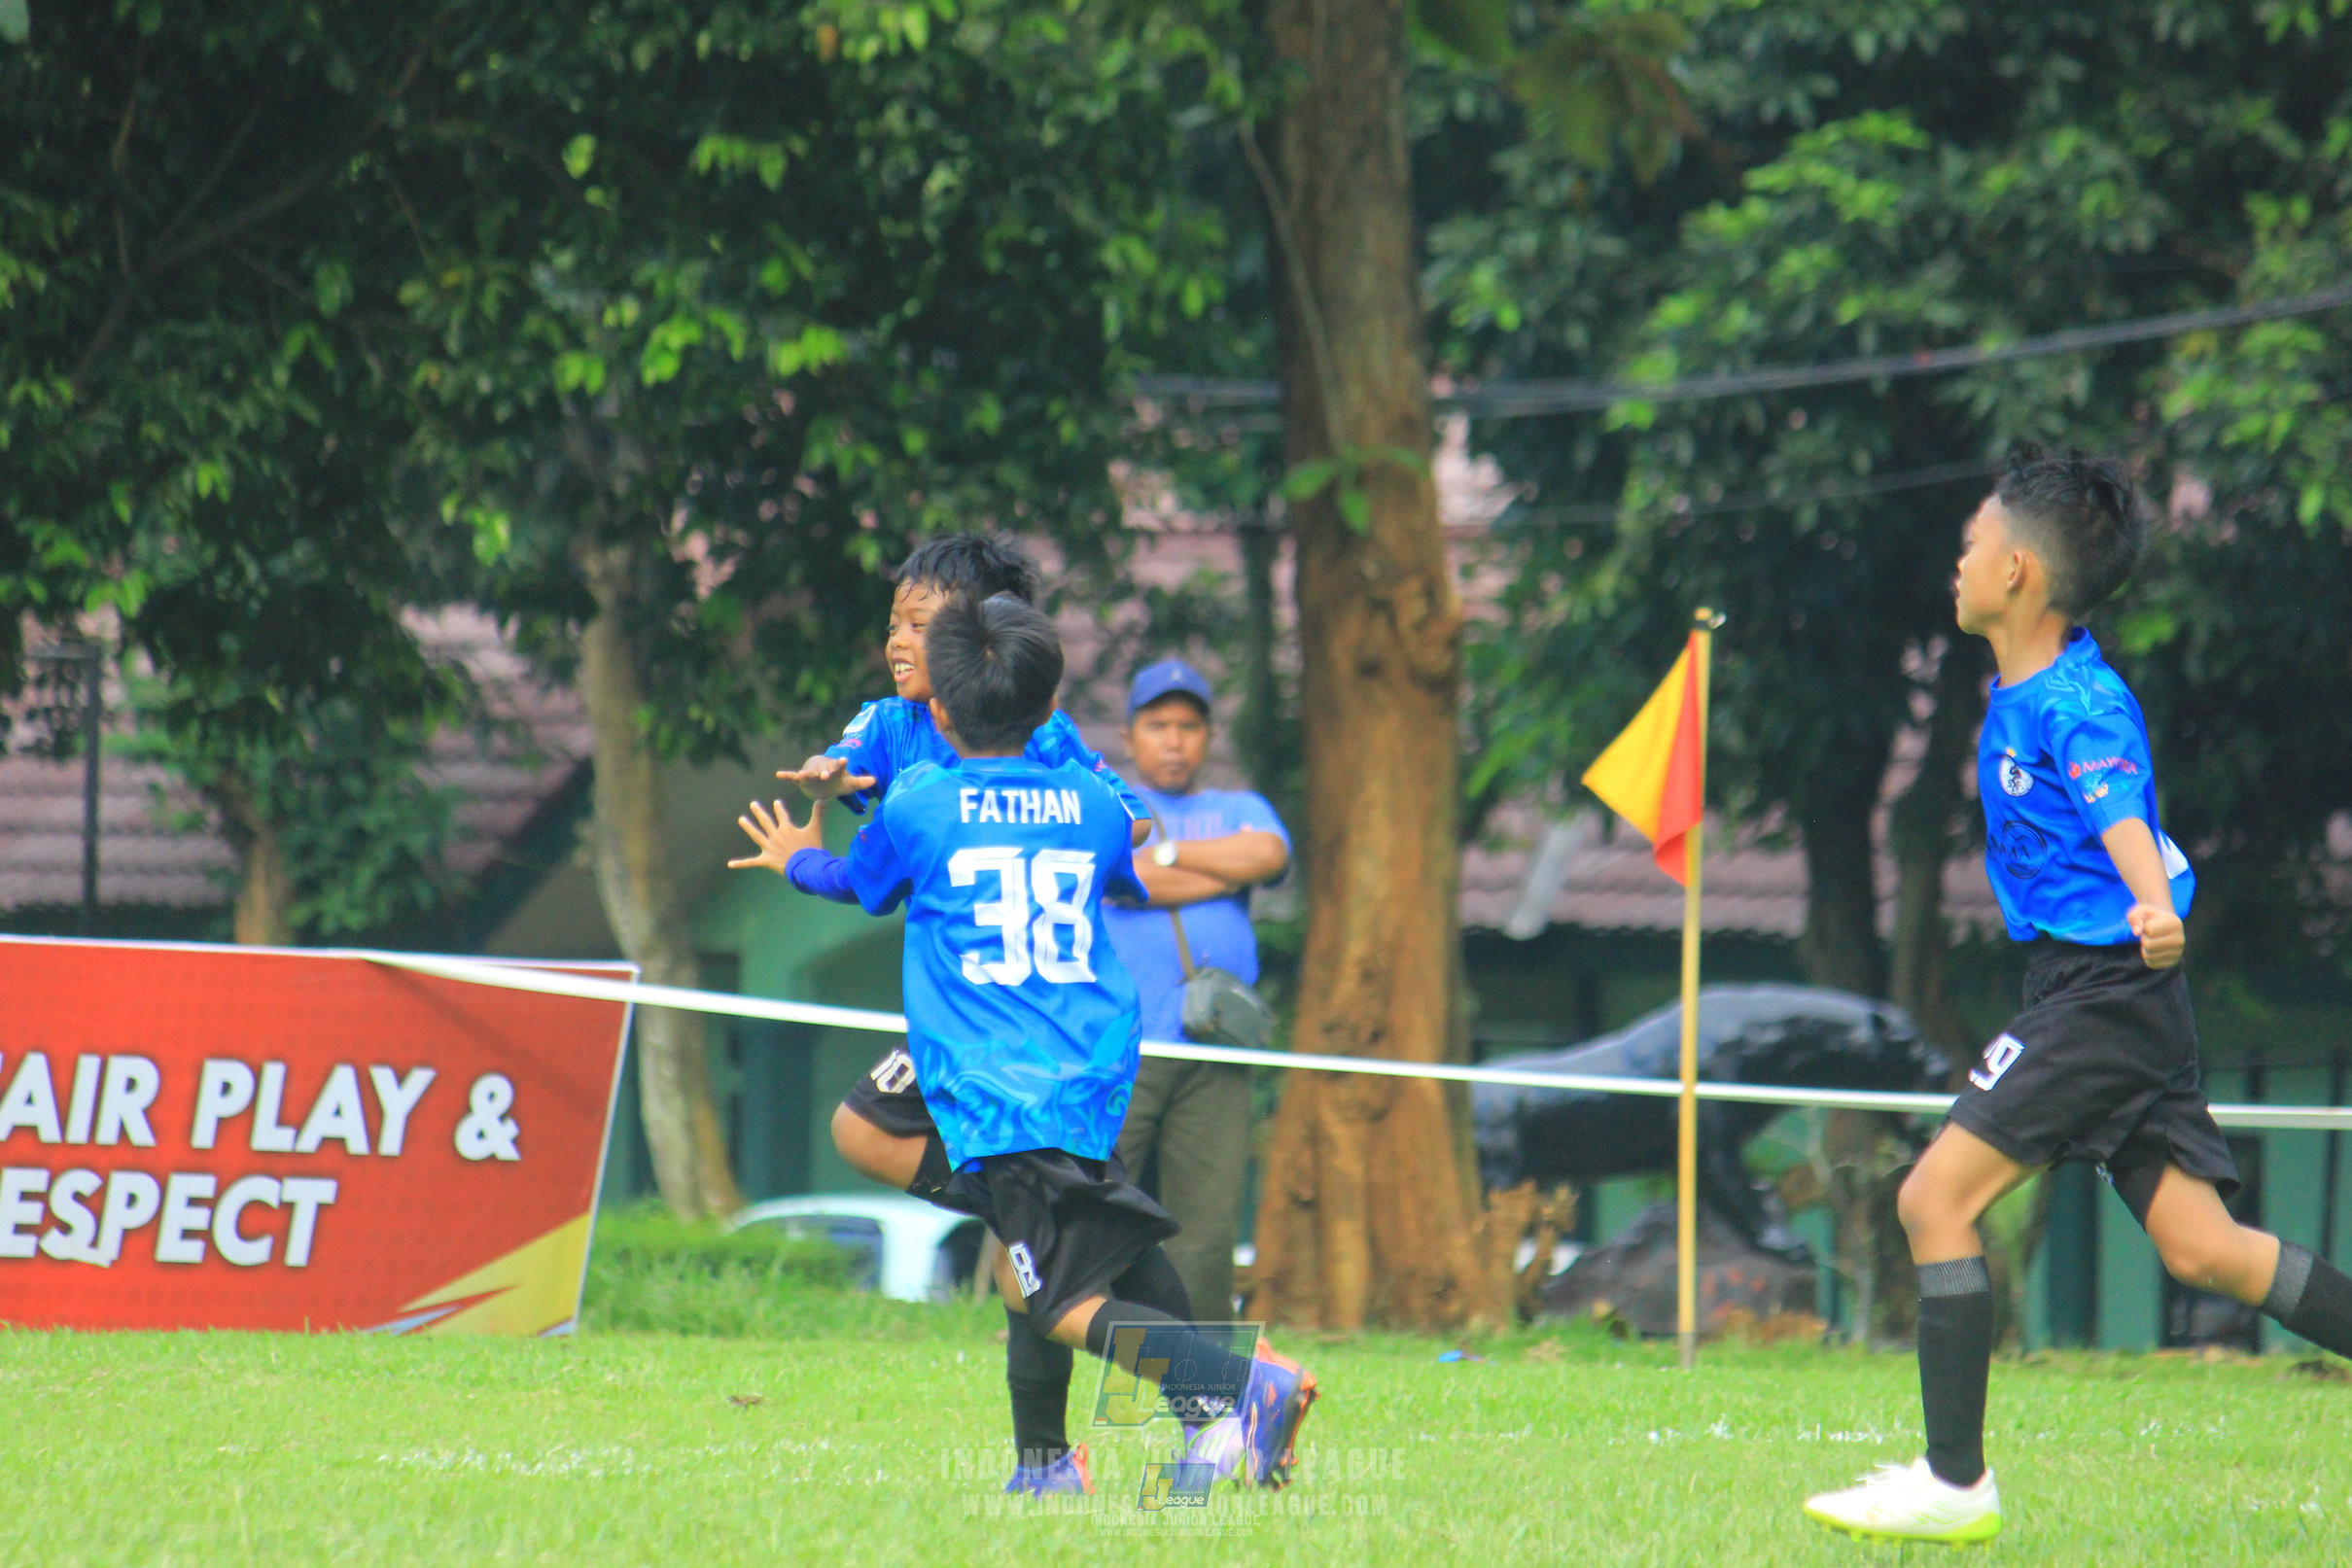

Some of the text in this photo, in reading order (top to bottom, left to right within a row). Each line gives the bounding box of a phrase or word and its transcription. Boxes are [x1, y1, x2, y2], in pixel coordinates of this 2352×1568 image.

[960, 788, 1081, 824] FATHAN
[947, 847, 1097, 987] 38
[0, 1051, 521, 1161] AIR PLAY &
